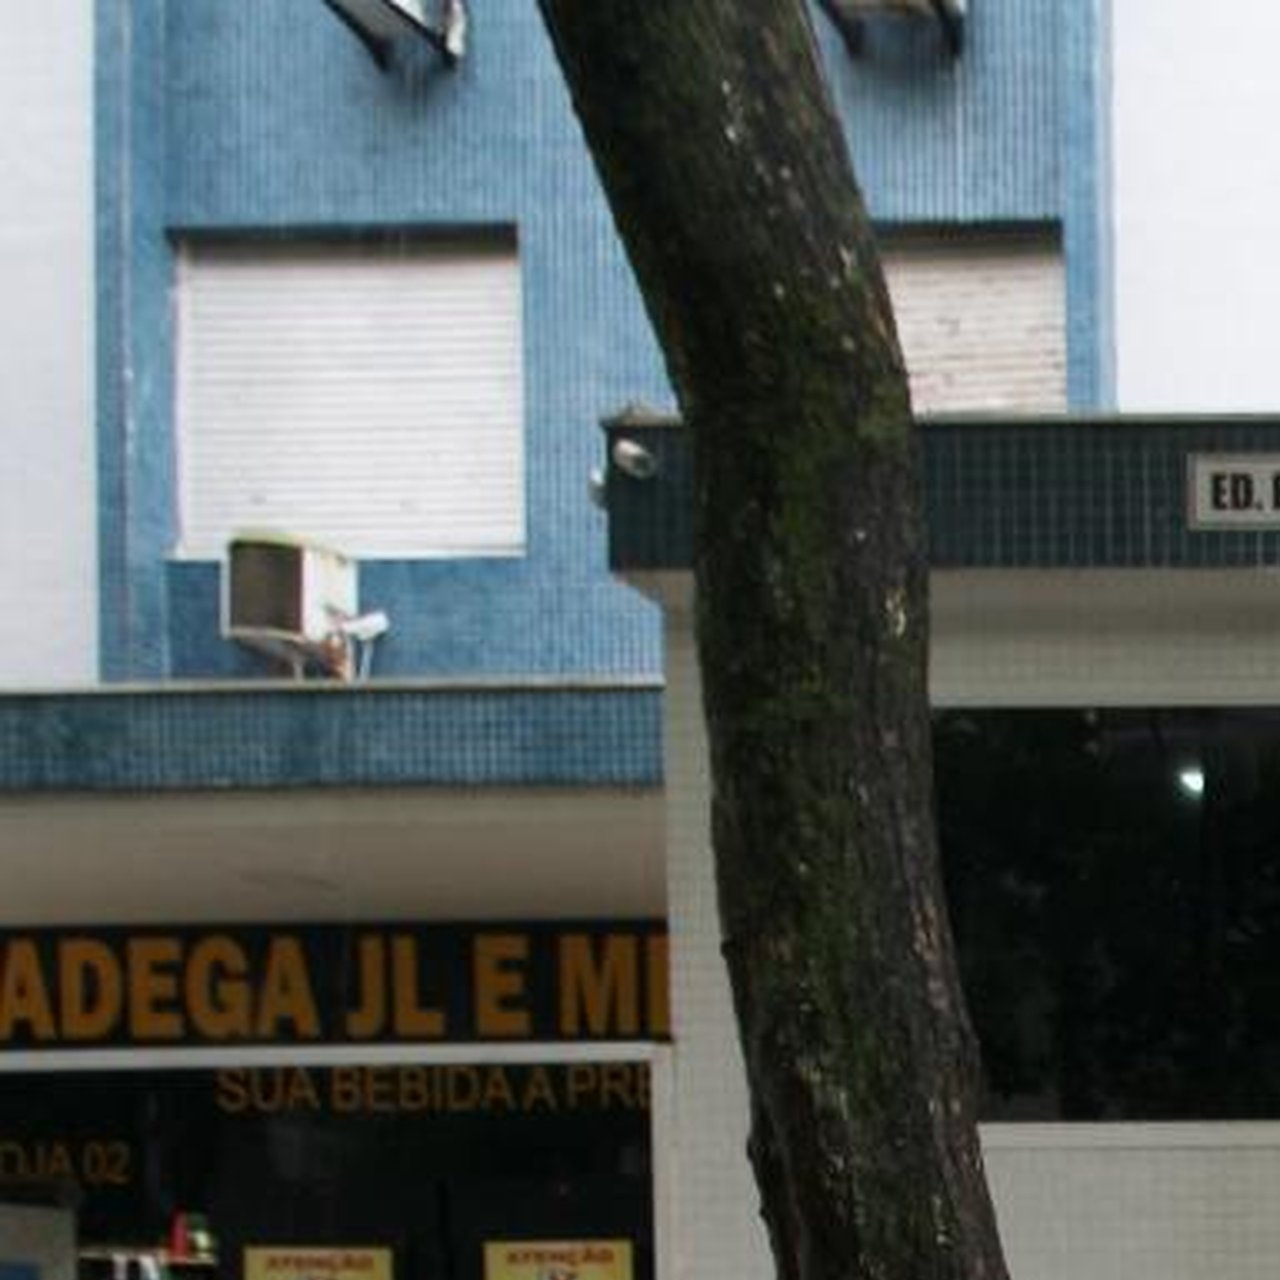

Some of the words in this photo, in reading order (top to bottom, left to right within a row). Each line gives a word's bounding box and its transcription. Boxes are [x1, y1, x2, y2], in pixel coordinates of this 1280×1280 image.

[1210, 473, 1263, 510] ED.
[0, 935, 319, 1041] ADEGA
[346, 934, 445, 1038] JL
[474, 933, 531, 1037] E
[214, 1065, 321, 1112] SUA
[331, 1065, 517, 1111] BEBIDA
[521, 1066, 559, 1110] A
